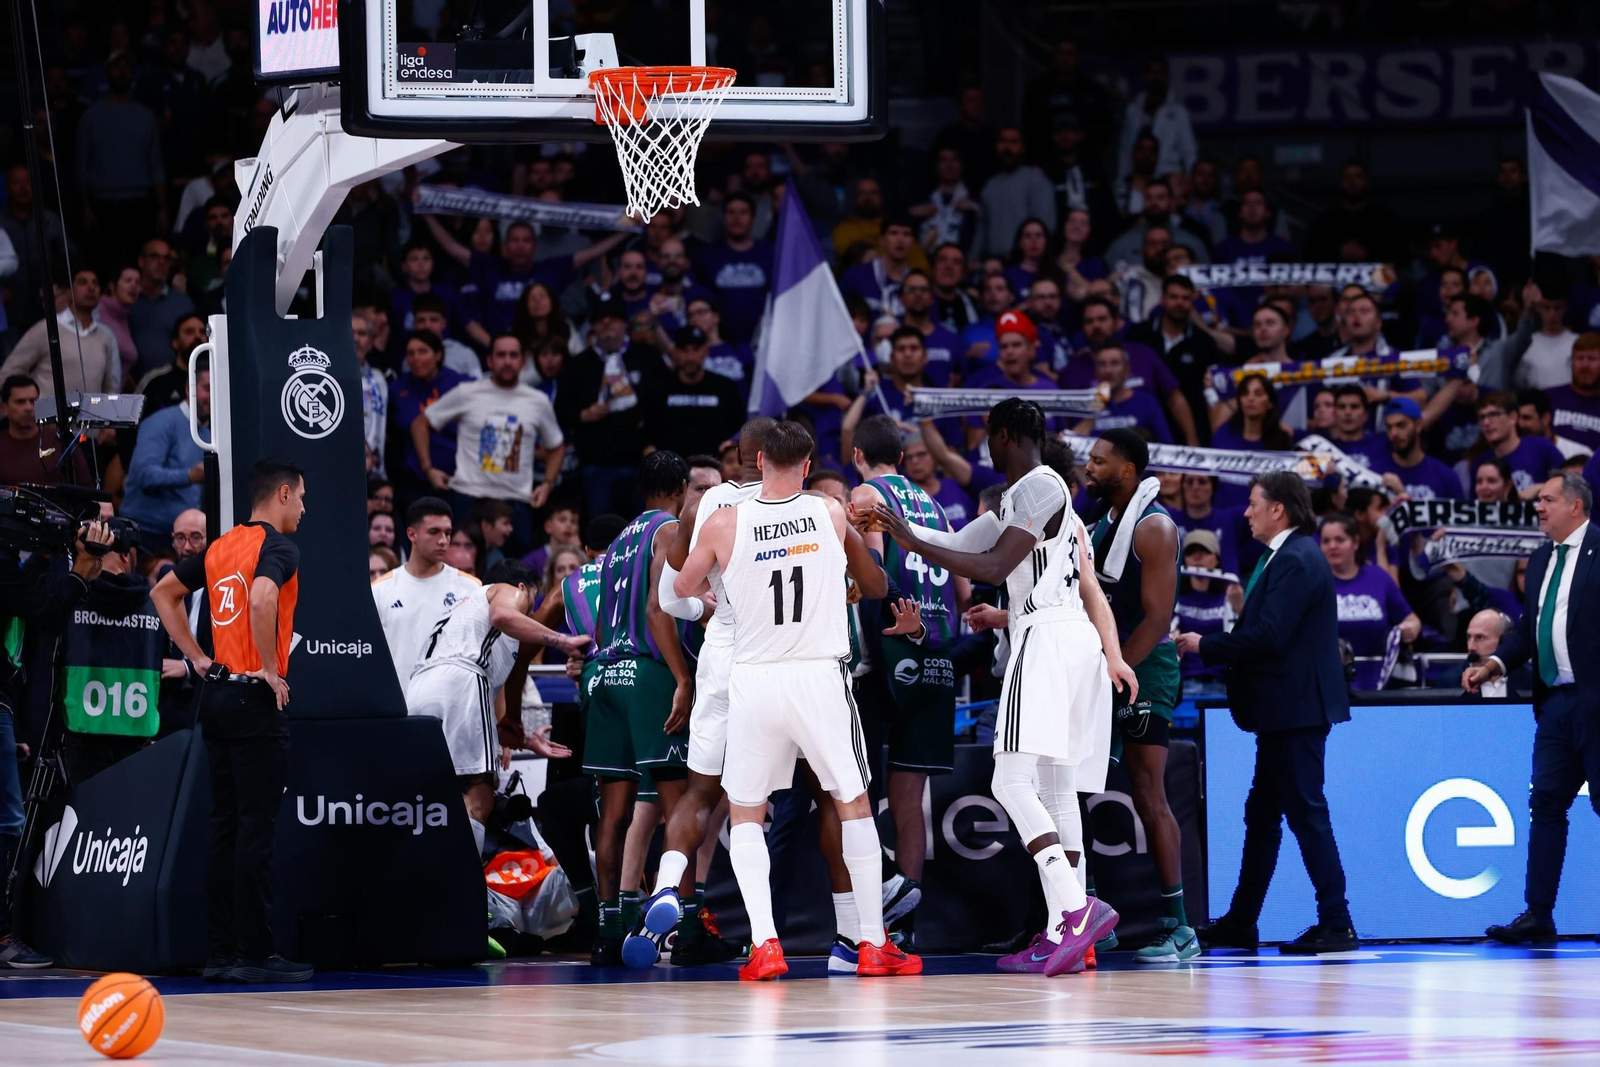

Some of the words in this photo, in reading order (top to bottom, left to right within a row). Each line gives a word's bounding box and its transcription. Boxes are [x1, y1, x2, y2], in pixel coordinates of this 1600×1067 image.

[400, 54, 424, 68] liga
[401, 67, 452, 79] endesa
[620, 520, 650, 540] orter
[754, 517, 817, 541] HEZONJA
[754, 543, 819, 561] AUTOHERO
[218, 586, 234, 613] 74
[768, 566, 804, 625] 11
[306, 639, 373, 658] Unicaja
[604, 669, 618, 678] DEL
[619, 669, 636, 678] SOL
[923, 658, 954, 670] COSTA
[923, 669, 941, 677] DEL
[83, 680, 148, 718] 016
[297, 794, 448, 835] Unicaja
[73, 824, 148, 887] Unicaja
